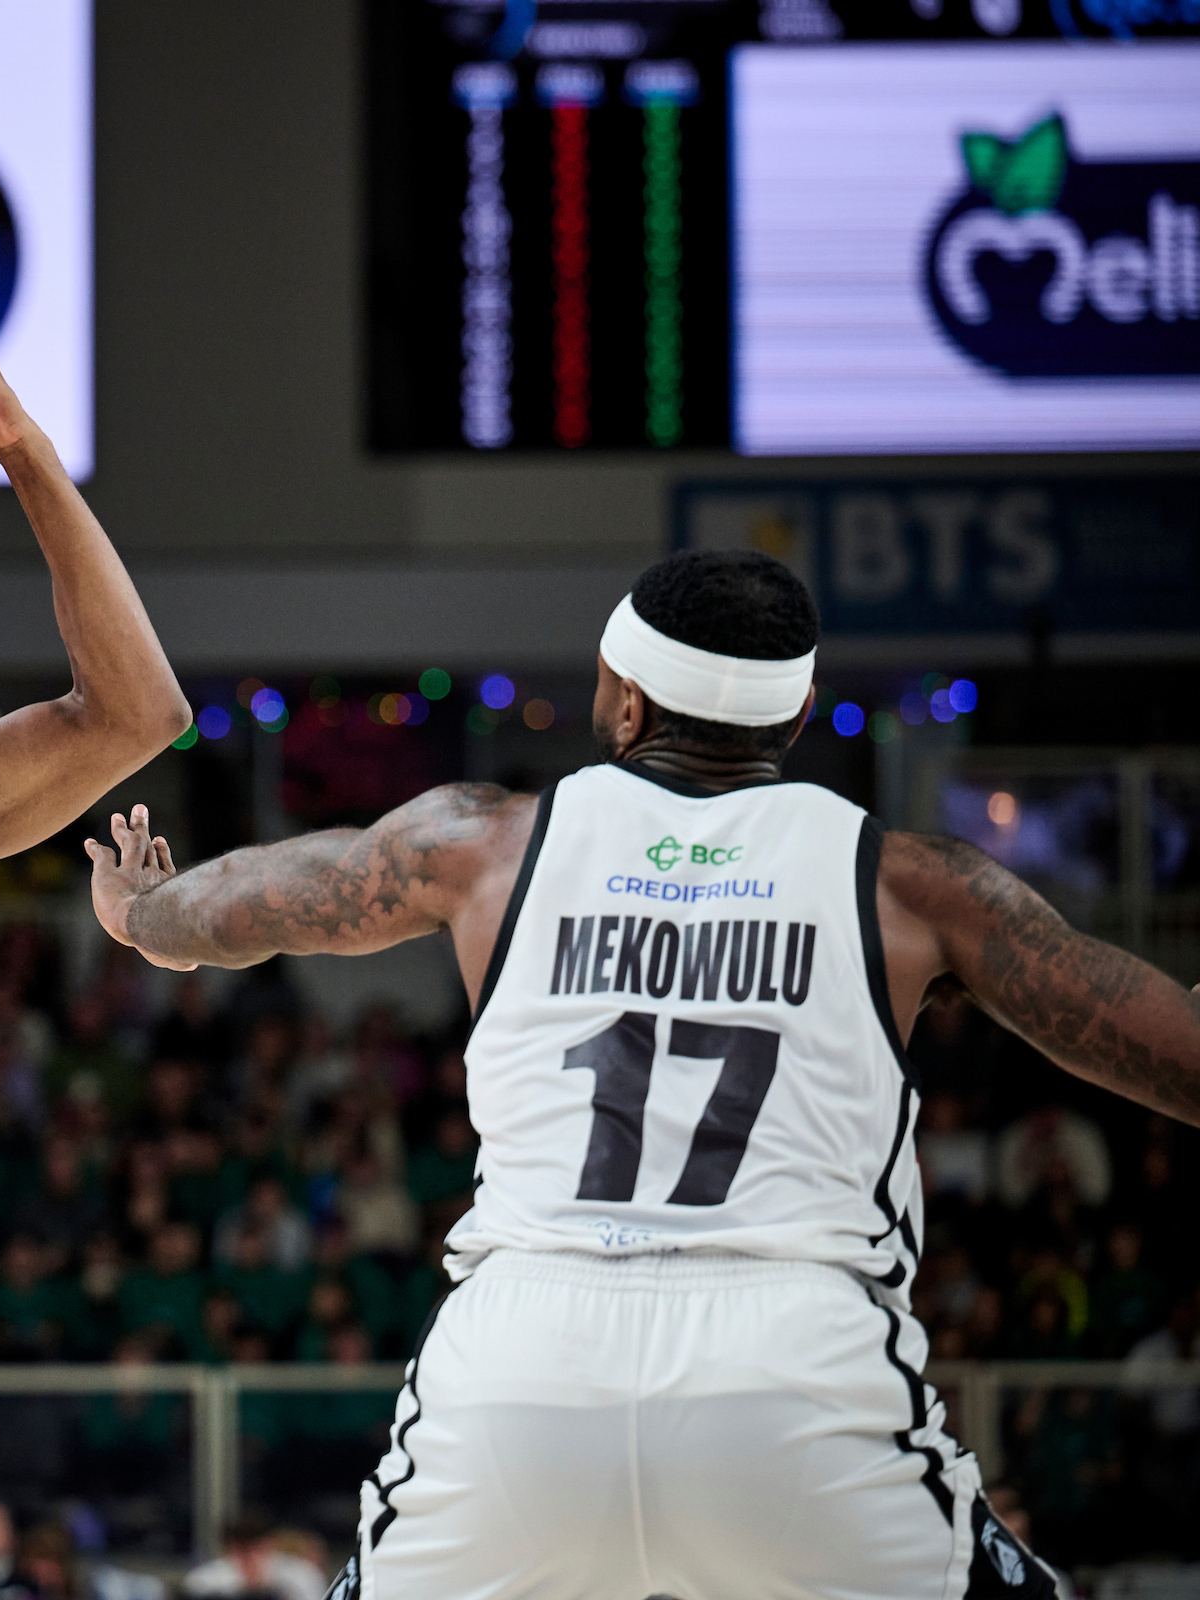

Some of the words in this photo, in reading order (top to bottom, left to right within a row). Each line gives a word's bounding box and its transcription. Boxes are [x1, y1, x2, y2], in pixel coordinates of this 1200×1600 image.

[831, 491, 1057, 604] BTS
[607, 875, 774, 903] CREDIFRIULI
[690, 844, 744, 866] BCC
[550, 915, 816, 1006] MEKOWULU
[562, 1011, 781, 1206] 17
